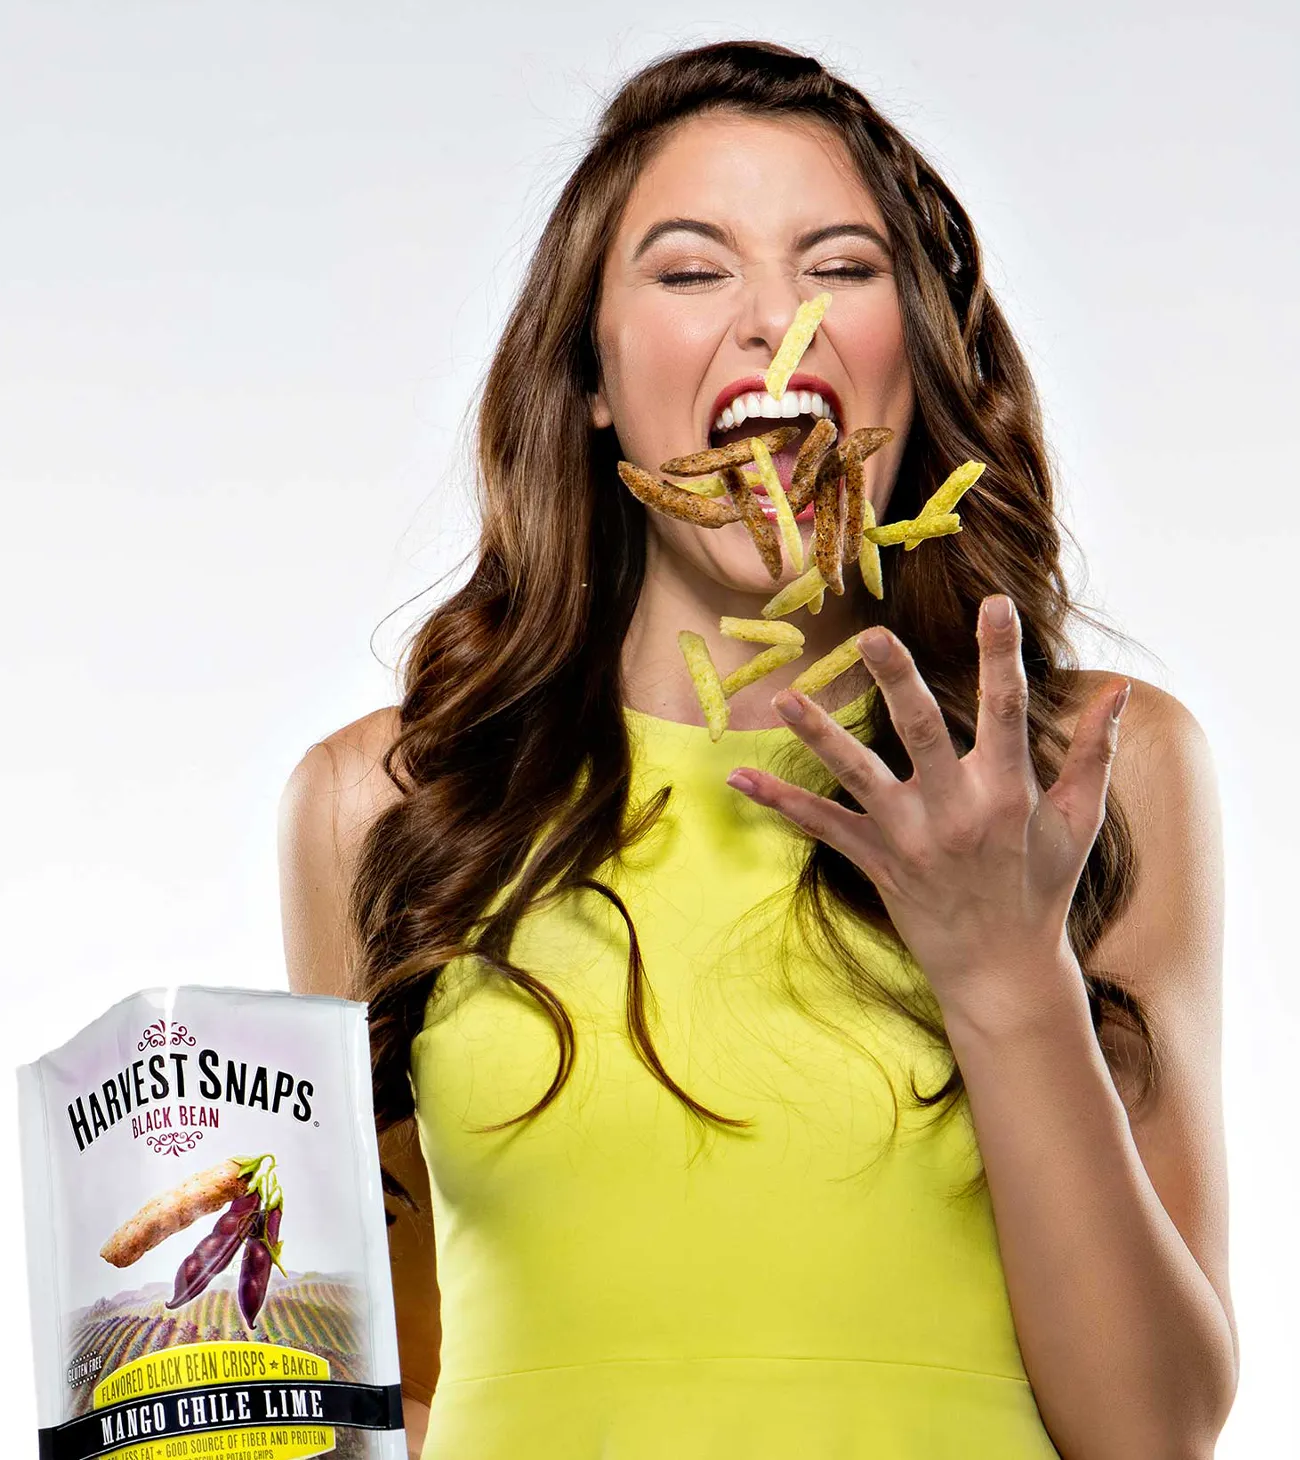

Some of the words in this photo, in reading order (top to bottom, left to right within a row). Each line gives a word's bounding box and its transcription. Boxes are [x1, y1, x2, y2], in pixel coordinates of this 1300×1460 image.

[67, 1053, 189, 1152] HARVEST
[198, 1049, 315, 1123] SNAPS
[131, 1106, 172, 1139] BLACK
[179, 1105, 220, 1129] BEAN
[67, 1362, 88, 1382] GLUTEN
[89, 1355, 102, 1373] FREE
[101, 1370, 144, 1403] FLAVORED
[146, 1356, 182, 1389] BLACK
[187, 1352, 219, 1381] BEAN
[222, 1351, 267, 1378] CRISPS
[282, 1354, 319, 1377] BAKED
[100, 1401, 167, 1446] MANGO
[177, 1391, 252, 1428] CHILE
[264, 1389, 325, 1419] LIME
[140, 1446, 154, 1460] FAT
[165, 1440, 188, 1458] GOOD
[190, 1435, 225, 1454] SOURCE
[227, 1434, 238, 1450] OF
[241, 1431, 267, 1448] FIBER
[269, 1429, 289, 1446] AND
[291, 1429, 328, 1447] PROTEIN
[226, 1451, 252, 1460] POTATO
[253, 1449, 274, 1460] CHIPS
